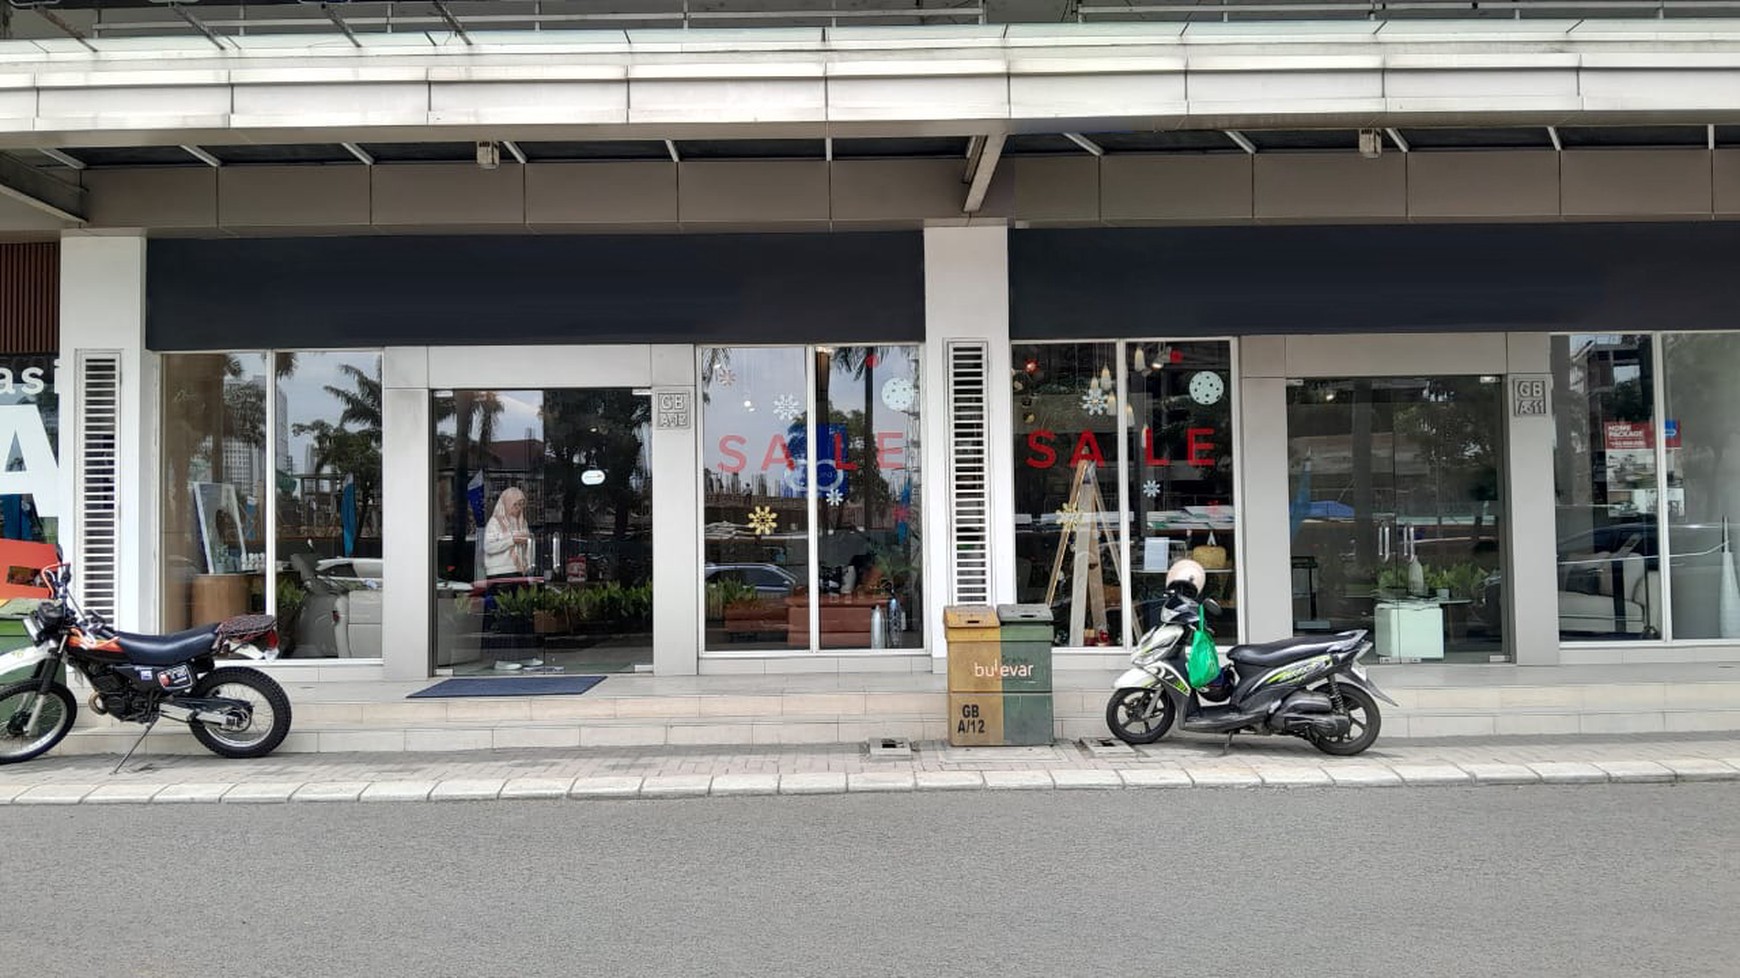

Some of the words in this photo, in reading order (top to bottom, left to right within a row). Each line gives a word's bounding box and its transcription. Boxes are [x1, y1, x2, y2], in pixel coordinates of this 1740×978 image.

[1519, 381, 1543, 397] GB
[661, 394, 685, 410] GB
[717, 431, 905, 474] SALE
[1026, 428, 1216, 469] SALE
[974, 658, 1034, 678] bulevar
[962, 704, 980, 718] GB
[957, 719, 985, 734] A/12
